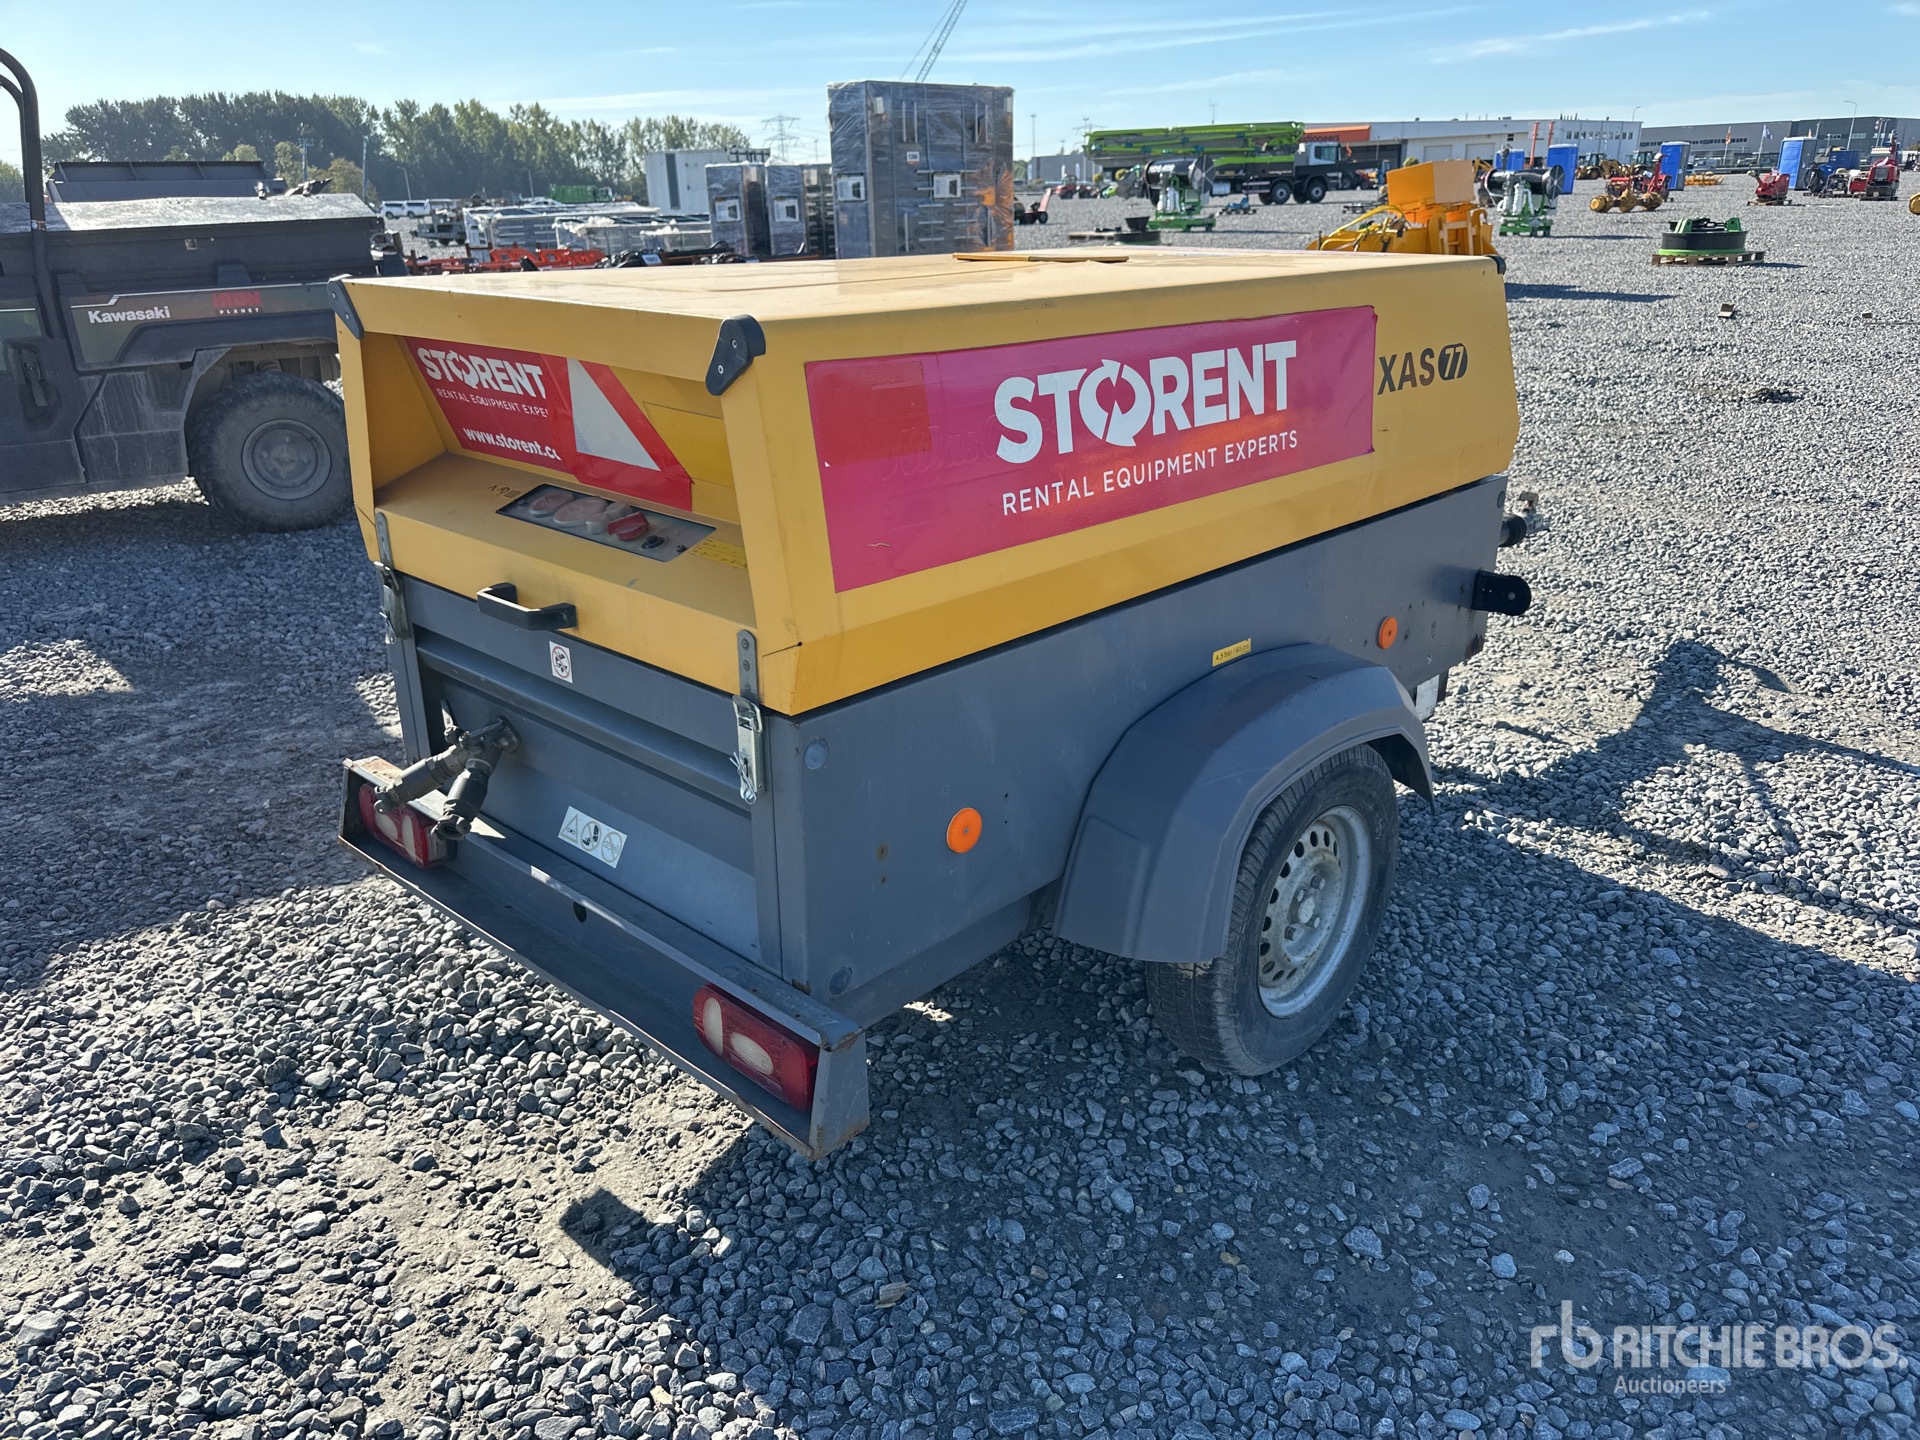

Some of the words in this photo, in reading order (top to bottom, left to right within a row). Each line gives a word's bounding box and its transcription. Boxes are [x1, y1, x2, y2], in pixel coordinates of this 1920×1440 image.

[88, 306, 170, 324] Kawasaki
[417, 347, 546, 399] STORENT
[1377, 347, 1435, 395] XAS
[436, 388, 471, 402] RENTAL
[472, 394, 520, 412] EQUIPMENT
[993, 340, 1297, 464] STORENT
[1002, 475, 1094, 516] RENTAL
[1103, 447, 1217, 492] EQUIPMENT
[1224, 430, 1298, 464] EXPERTS
